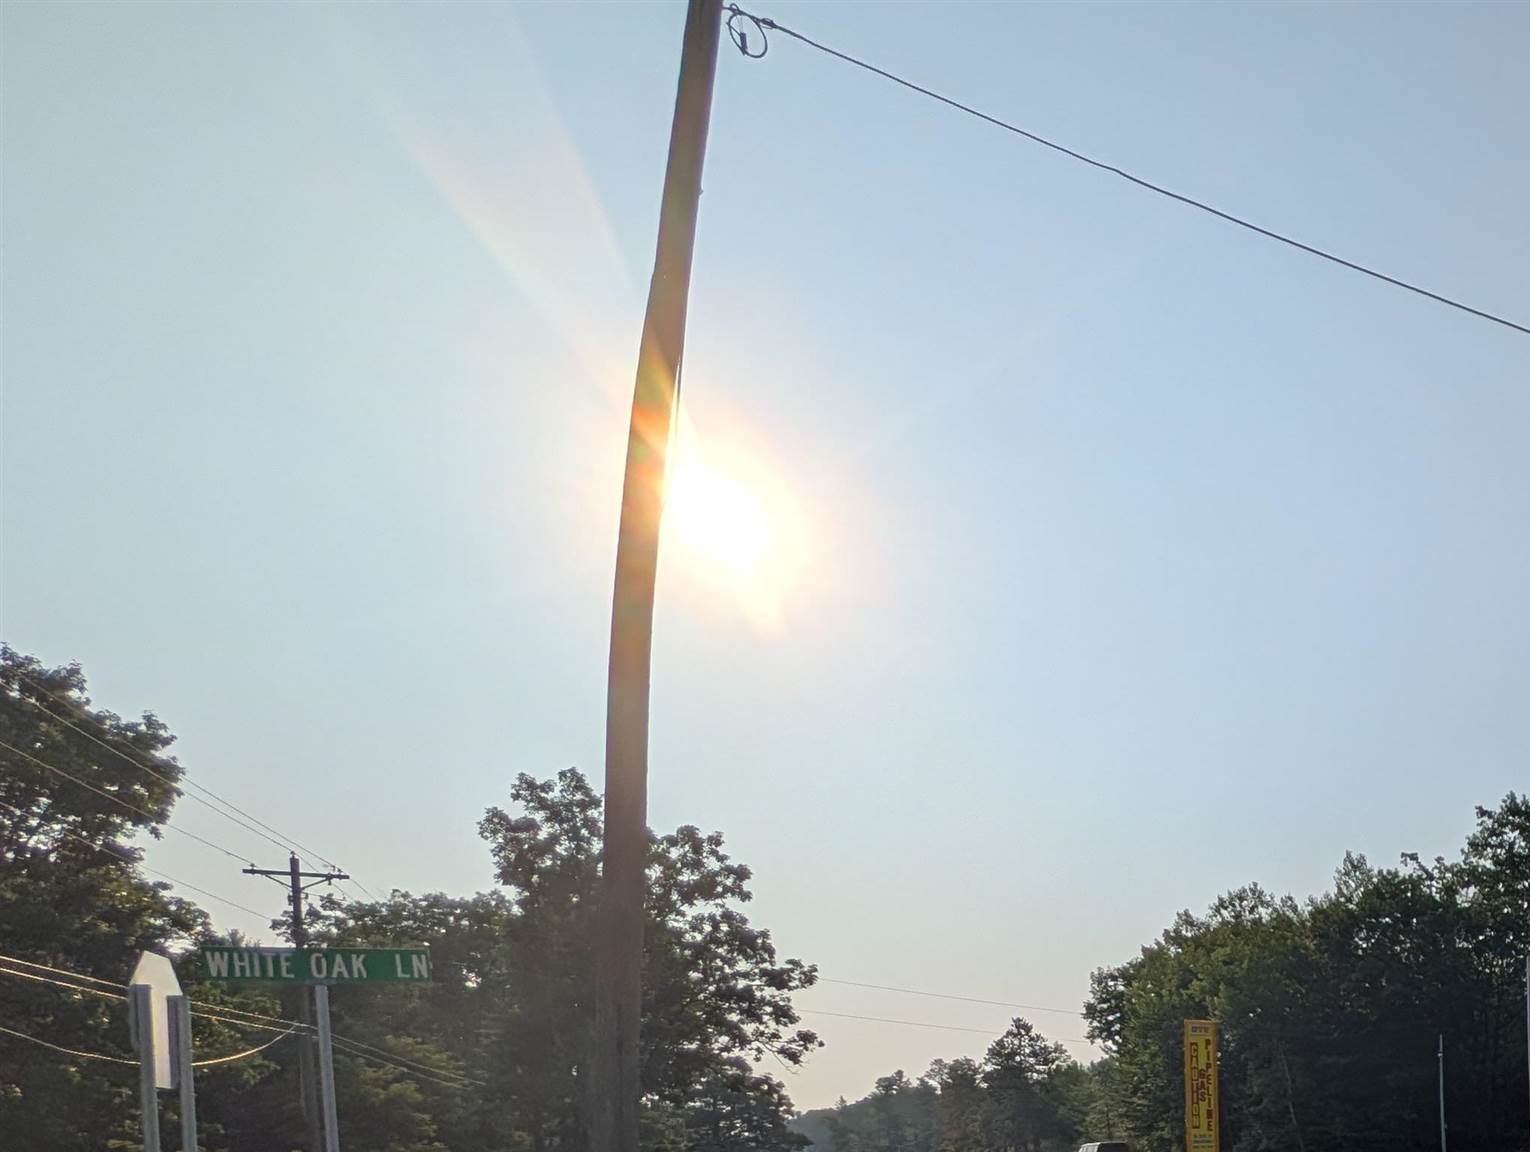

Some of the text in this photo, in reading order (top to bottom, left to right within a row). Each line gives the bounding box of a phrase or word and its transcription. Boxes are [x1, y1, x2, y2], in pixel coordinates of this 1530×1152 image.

[205, 951, 429, 979] WHITE OAK LN
[1190, 1043, 1200, 1128] CAUTION
[1199, 1070, 1207, 1102] GAS
[1204, 1038, 1213, 1132] PIPELINE
